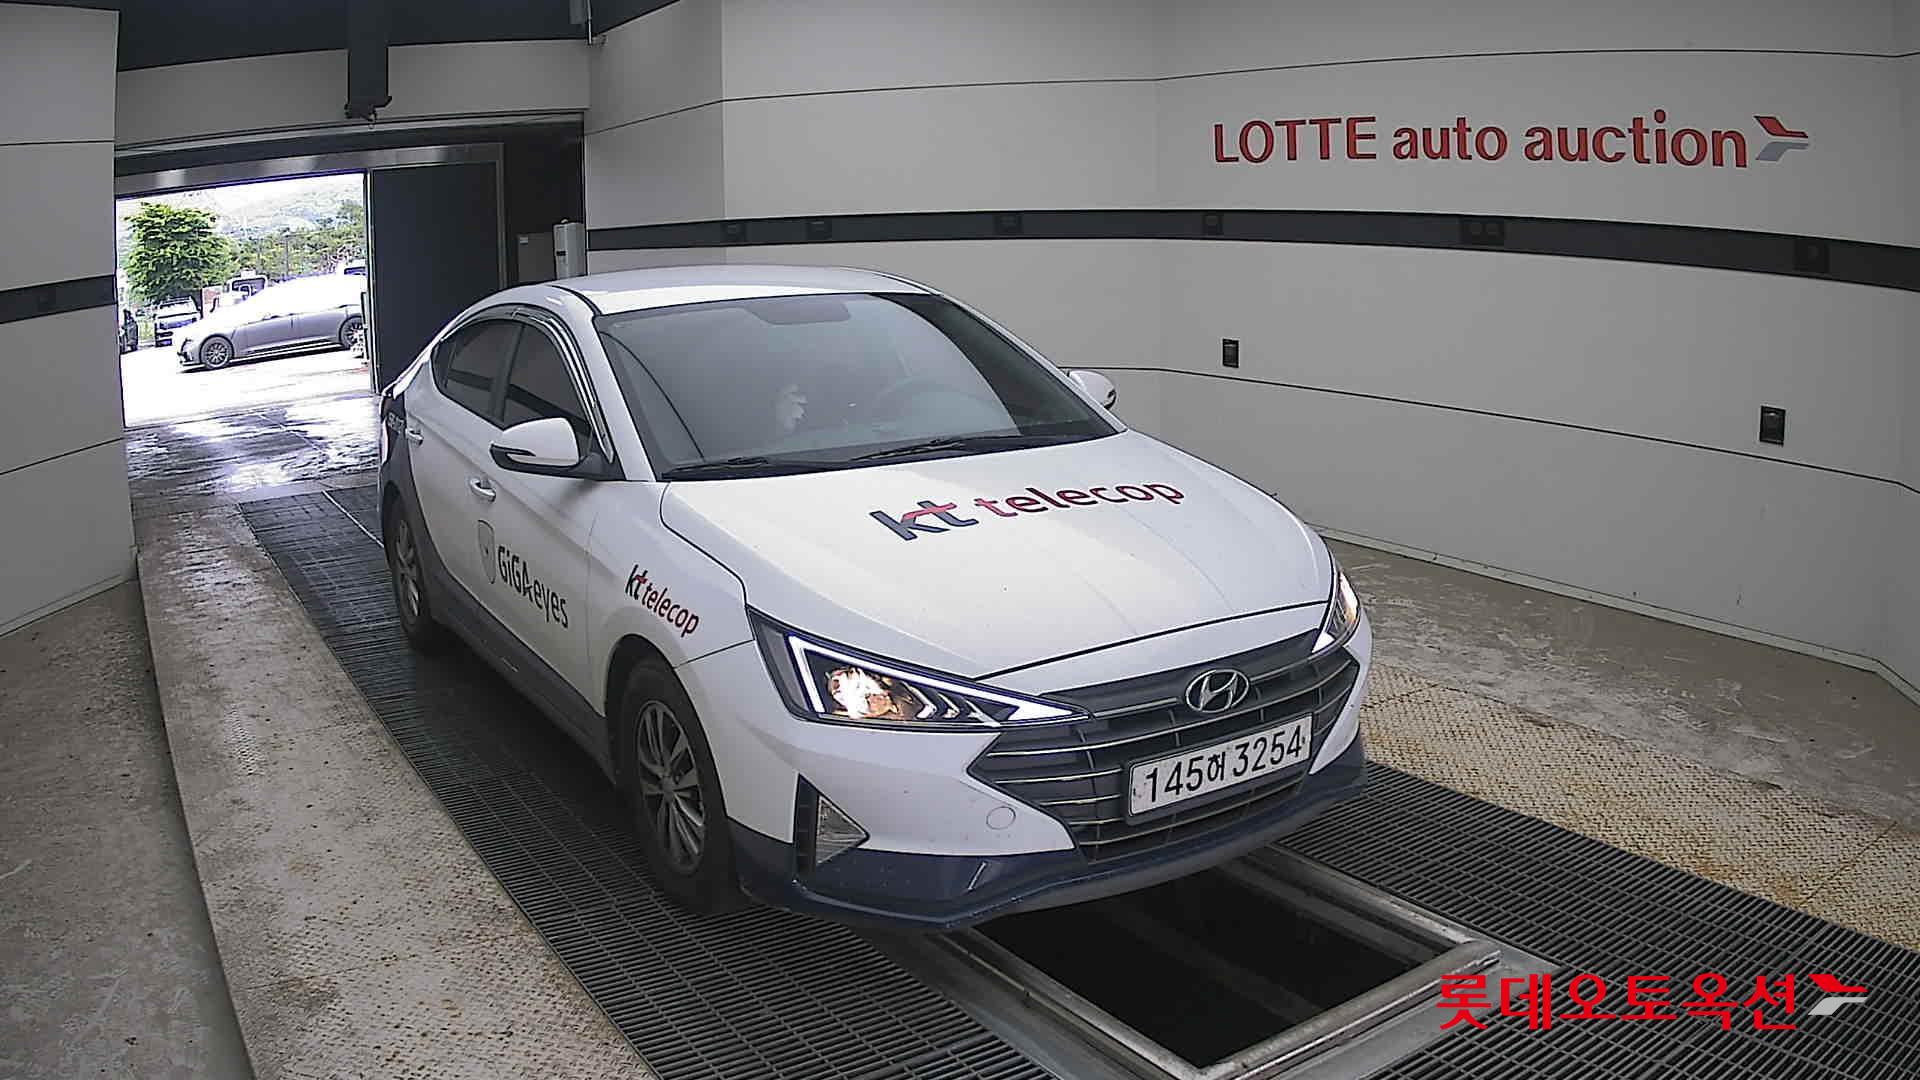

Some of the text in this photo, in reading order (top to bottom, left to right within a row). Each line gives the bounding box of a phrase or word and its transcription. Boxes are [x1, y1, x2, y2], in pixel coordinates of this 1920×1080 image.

[1214, 109, 1748, 168] LOTTE auto auction
[869, 483, 1185, 541] kt telecop
[624, 564, 699, 638] kt telecop
